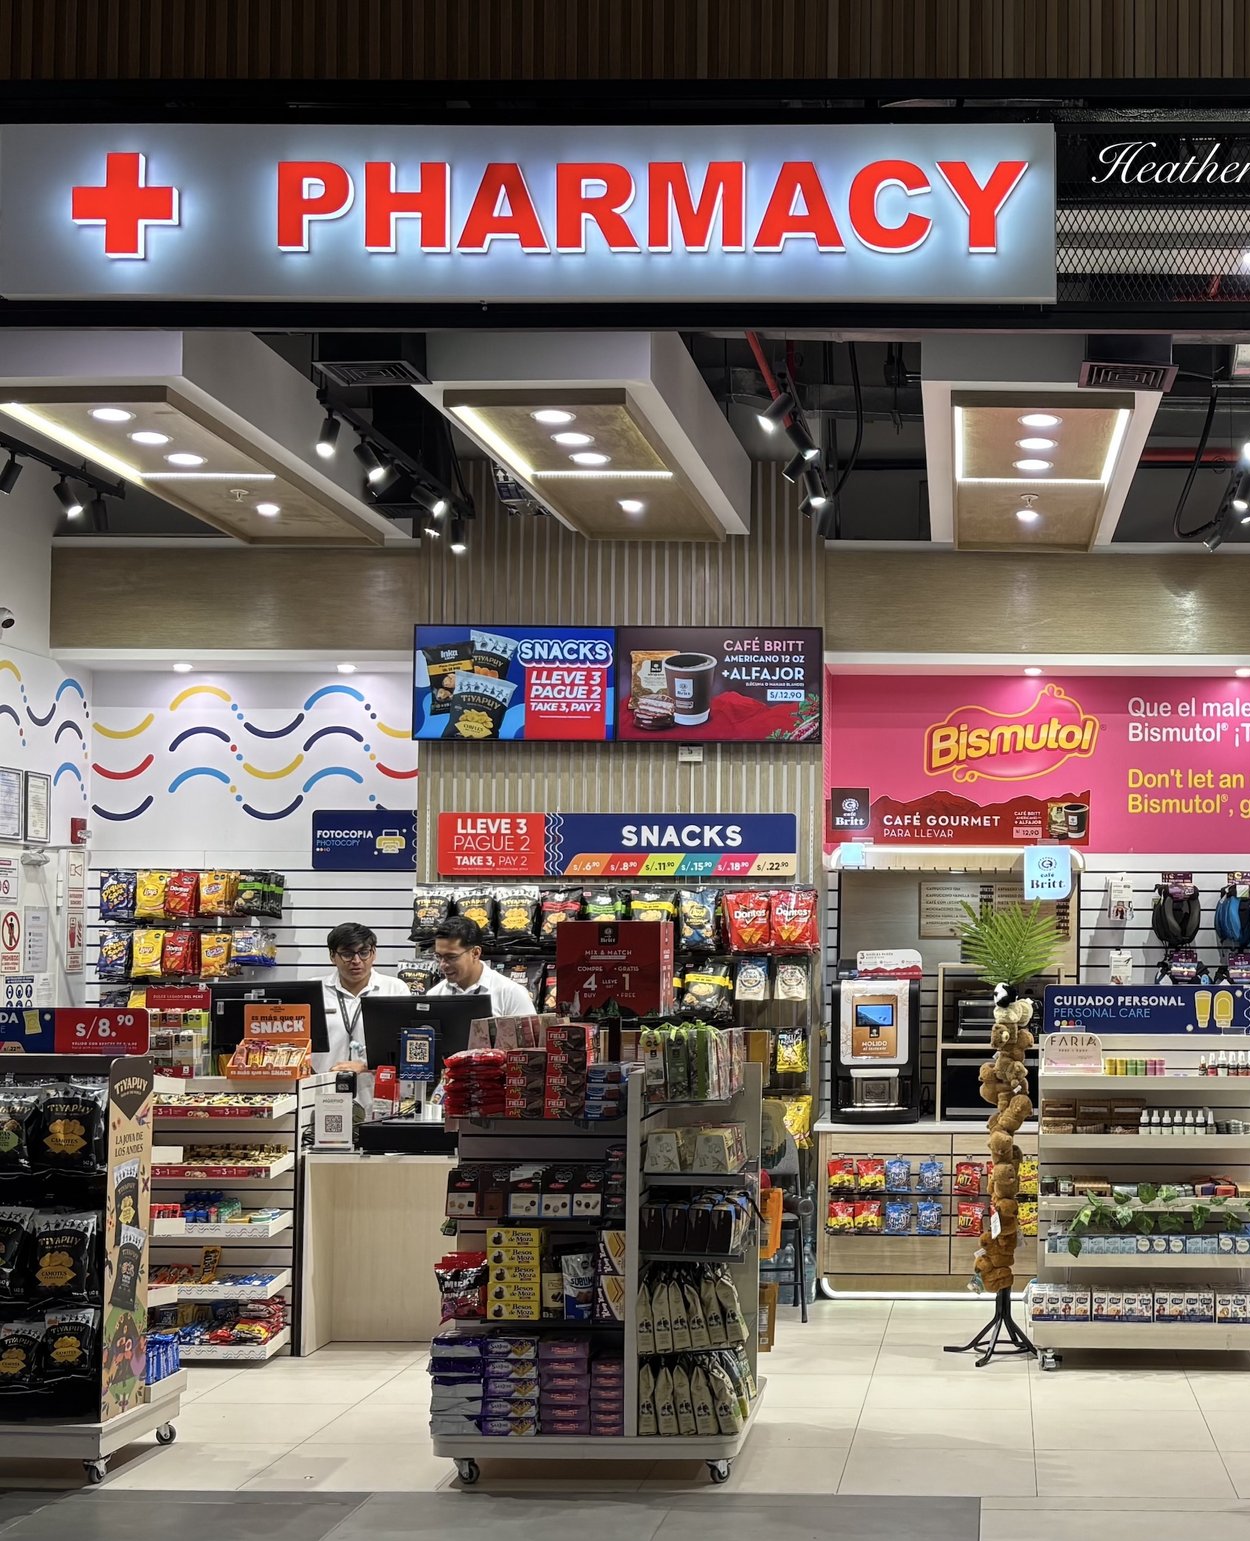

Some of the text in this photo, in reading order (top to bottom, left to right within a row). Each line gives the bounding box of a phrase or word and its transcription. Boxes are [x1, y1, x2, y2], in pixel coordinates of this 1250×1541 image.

[277, 159, 1029, 254] PHARMACY
[723, 636, 805, 652] CAFÉ BRITT
[521, 642, 608, 660] SNACKS
[724, 655, 805, 663] AMERICANO 12 OZ
[530, 671, 601, 684] LLEVE 3
[722, 667, 805, 680] +ALFAJOR
[530, 685, 602, 699] PAGUE 2
[530, 703, 601, 714] TAKE 3, PAY 2
[1128, 697, 1173, 719] Que
[1178, 697, 1197, 717] el
[931, 717, 1094, 768] Bismutol
[1128, 769, 1184, 789] Don't
[1188, 769, 1215, 789] let
[1219, 773, 1245, 789] an
[457, 818, 527, 834] LLEVE 3
[835, 816, 865, 826] Britt
[883, 814, 1000, 827] CAFÉ GOURMET
[316, 830, 373, 838] FOTOCOPIA
[621, 825, 743, 847] SNACKS
[883, 829, 954, 838] PARA LLEVAR
[453, 835, 530, 851] PAGUE 2
[456, 856, 527, 867] TAKE 3, PAY 2
[1030, 878, 1066, 889] Britt
[734, 909, 767, 920] Doritos
[775, 907, 808, 919] Doritos
[583, 974, 597, 990] 4
[622, 974, 630, 990] 1
[1054, 995, 1185, 1006] CUIDADO PERSONAL
[1053, 1008, 1151, 1018] PERSONAL CARE
[250, 1020, 305, 1034] SNACK
[114, 1144, 144, 1157] LOS ANDES
[957, 1175, 972, 1186] RITZ
